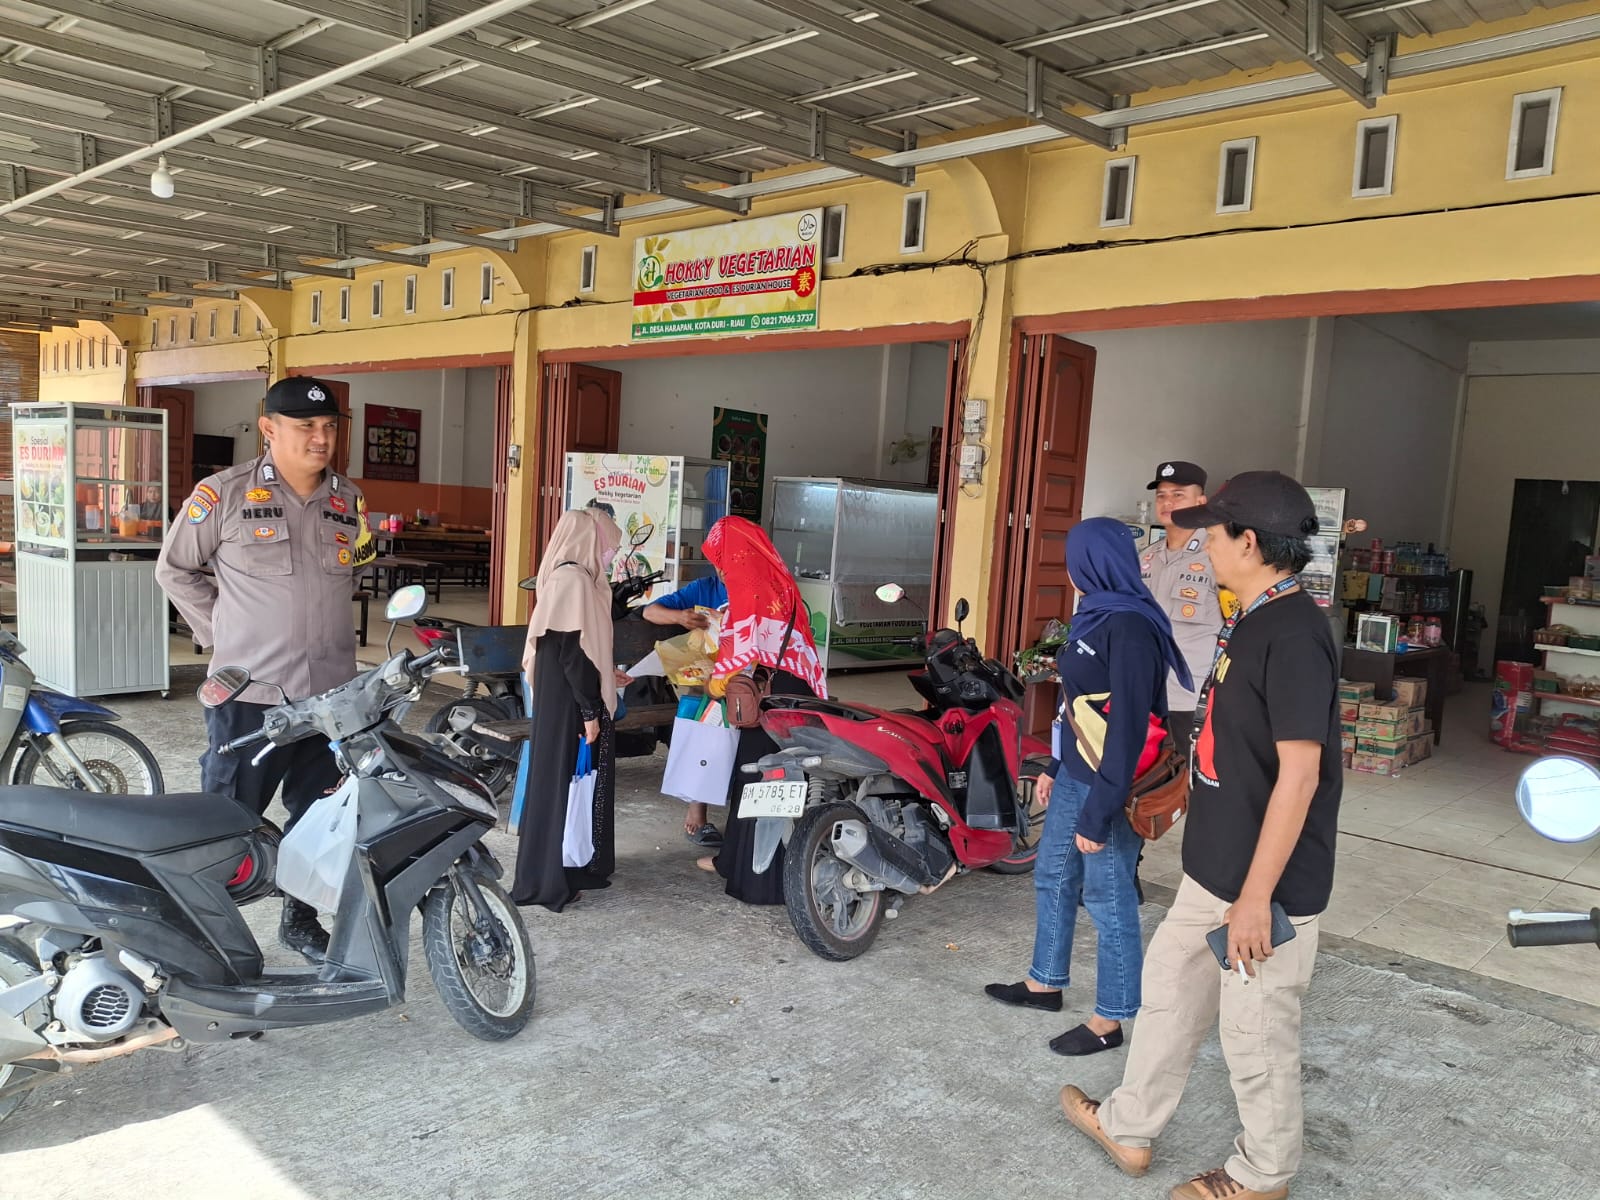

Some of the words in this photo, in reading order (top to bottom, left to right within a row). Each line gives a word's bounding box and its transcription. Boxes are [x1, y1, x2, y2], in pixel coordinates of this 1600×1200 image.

[665, 257, 714, 285] HOKKY
[719, 245, 816, 277] VEGETARIAN
[667, 289, 703, 300] VEGETARIAN
[705, 286, 723, 296] FOOD
[725, 286, 730, 294] &
[741, 281, 766, 291] DURIAN
[768, 279, 792, 289] HOUSE
[797, 271, 812, 293] 素
[650, 325, 665, 334] DESA
[665, 323, 693, 333] HARAPAN,
[694, 321, 711, 331] KOTA
[711, 320, 726, 329] DURI
[731, 319, 745, 327] RIAU
[761, 317, 777, 326] 0821
[778, 315, 796, 324] 7066
[797, 313, 814, 323] 3737
[19, 447, 30, 460] ES
[594, 477, 606, 491] ES
[608, 474, 646, 494] DURIAN
[243, 507, 283, 520] HERU
[1179, 574, 1208, 584] POLRI
[743, 786, 755, 800] BM
[758, 785, 784, 799] 5785
[789, 784, 804, 799] ET
